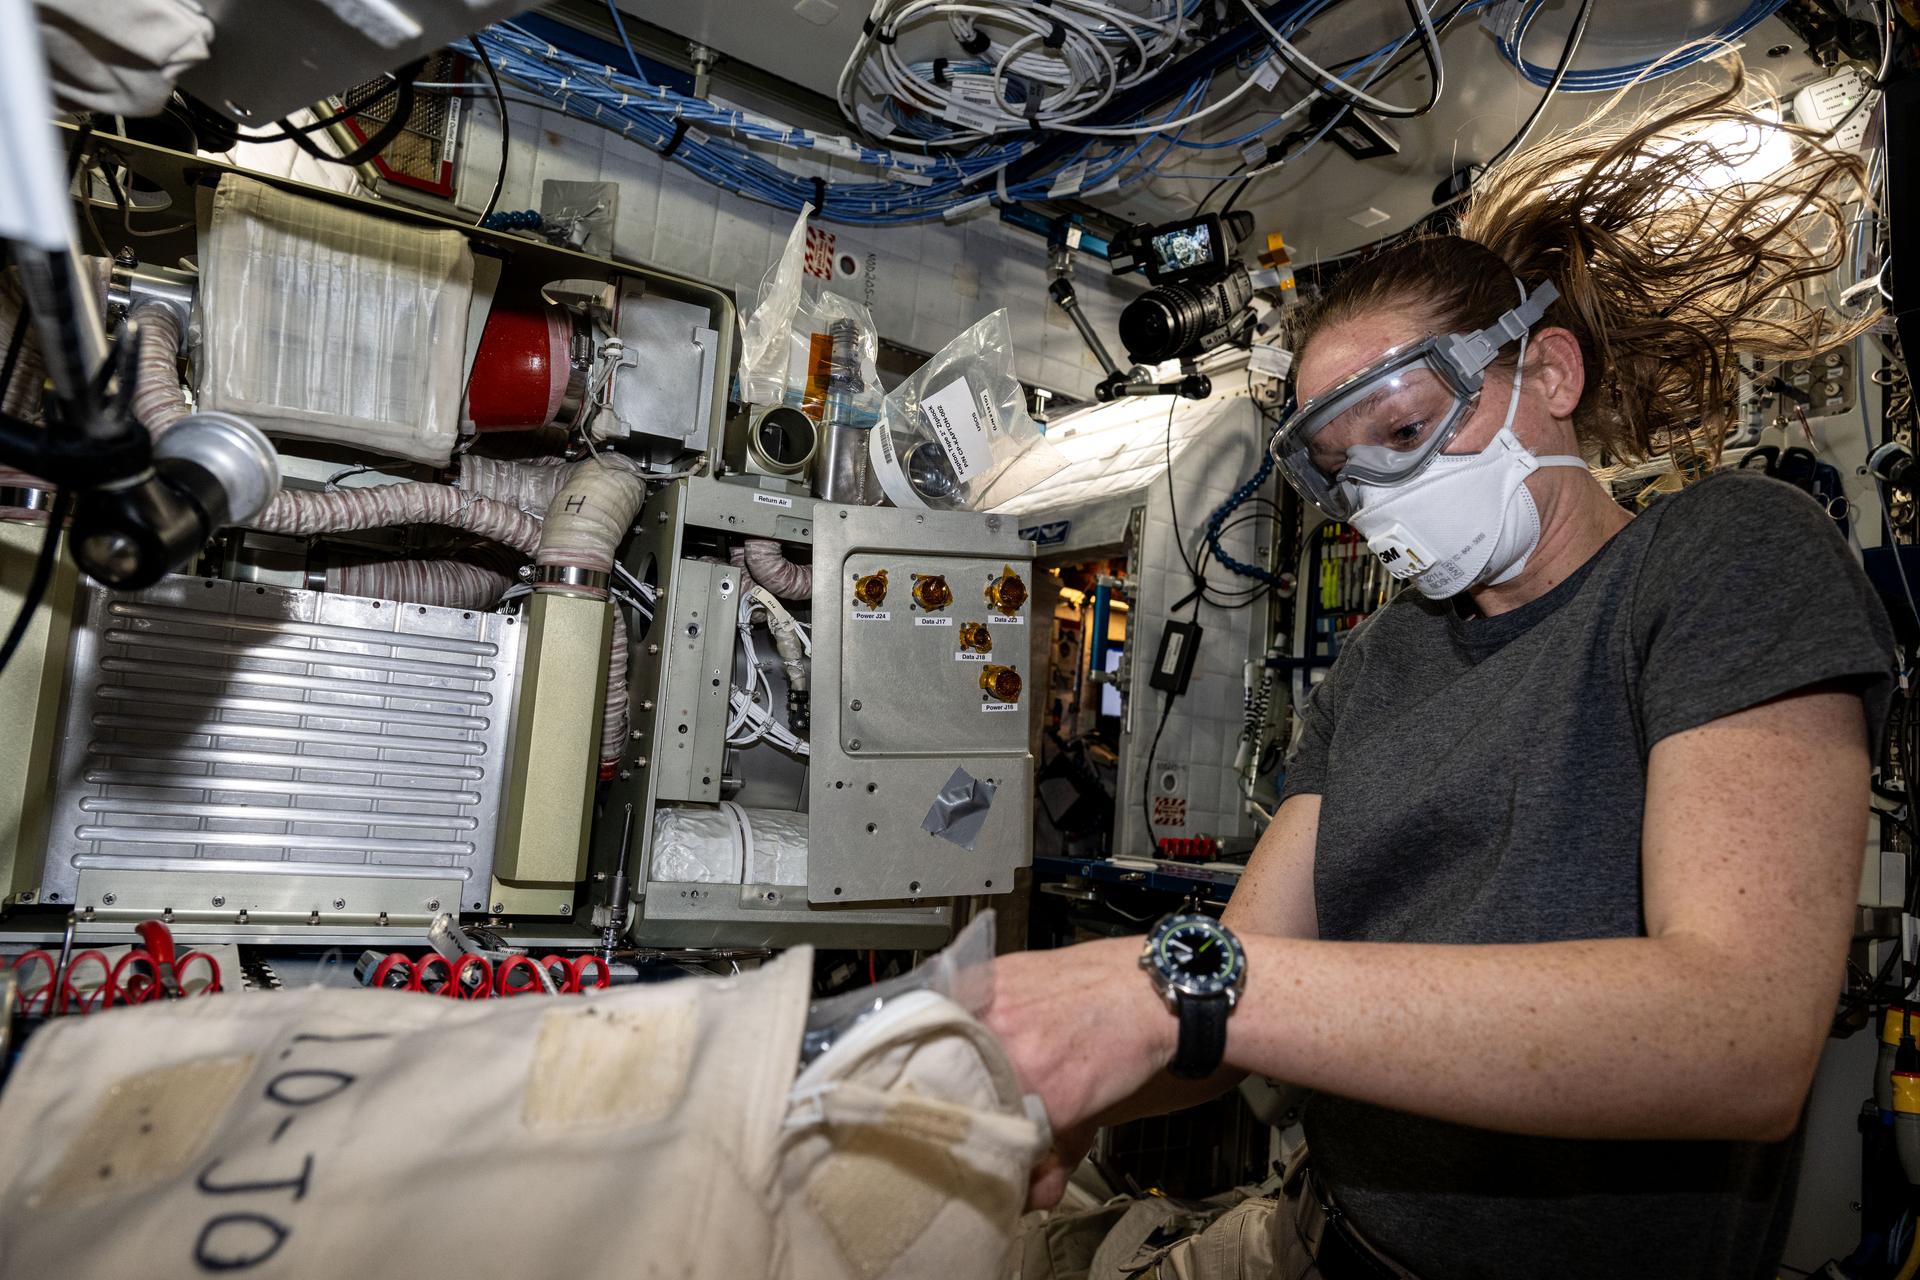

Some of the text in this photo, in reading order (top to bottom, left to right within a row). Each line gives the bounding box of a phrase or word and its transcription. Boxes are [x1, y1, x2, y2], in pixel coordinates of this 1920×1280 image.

[928, 405, 942, 429] Ziplock
[972, 412, 982, 432] USOS
[938, 404, 968, 468] P/N CP-KAPTON-002
[951, 452, 965, 476] Kapton
[565, 494, 585, 513] H
[758, 496, 777, 504] Return
[1379, 546, 1400, 565] 3M
